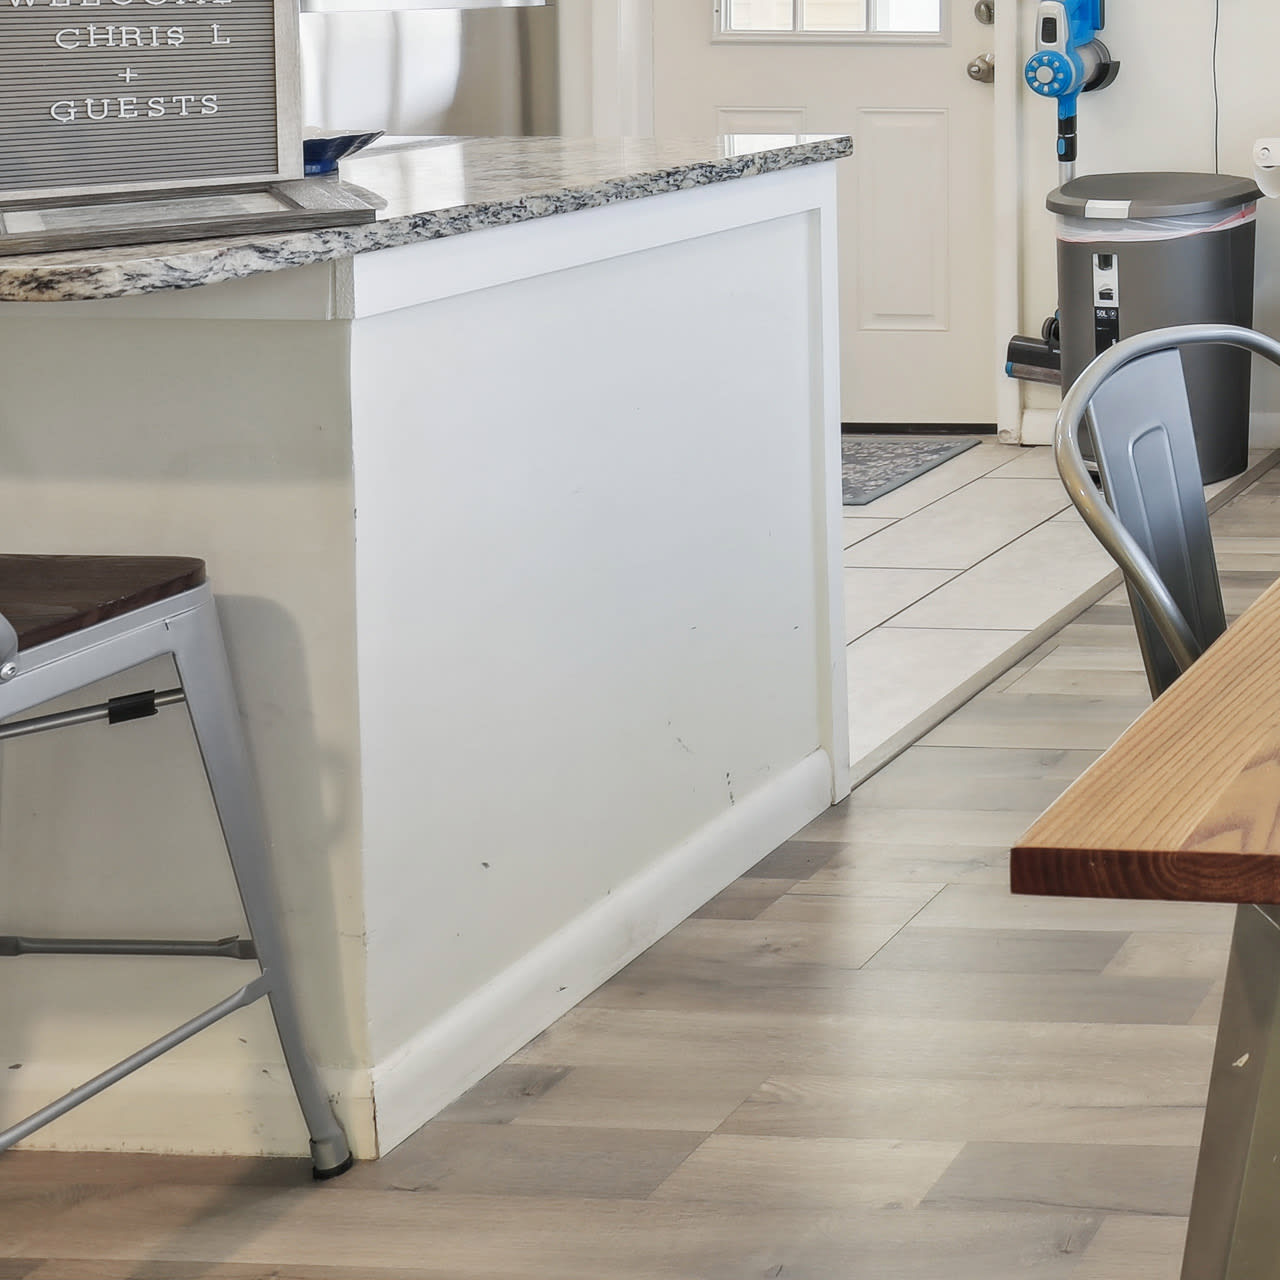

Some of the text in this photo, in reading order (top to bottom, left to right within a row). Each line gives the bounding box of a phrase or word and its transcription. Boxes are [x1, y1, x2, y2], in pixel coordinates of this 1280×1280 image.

[55, 23, 231, 50] CHRIS L
[50, 94, 220, 122] GUESTS
